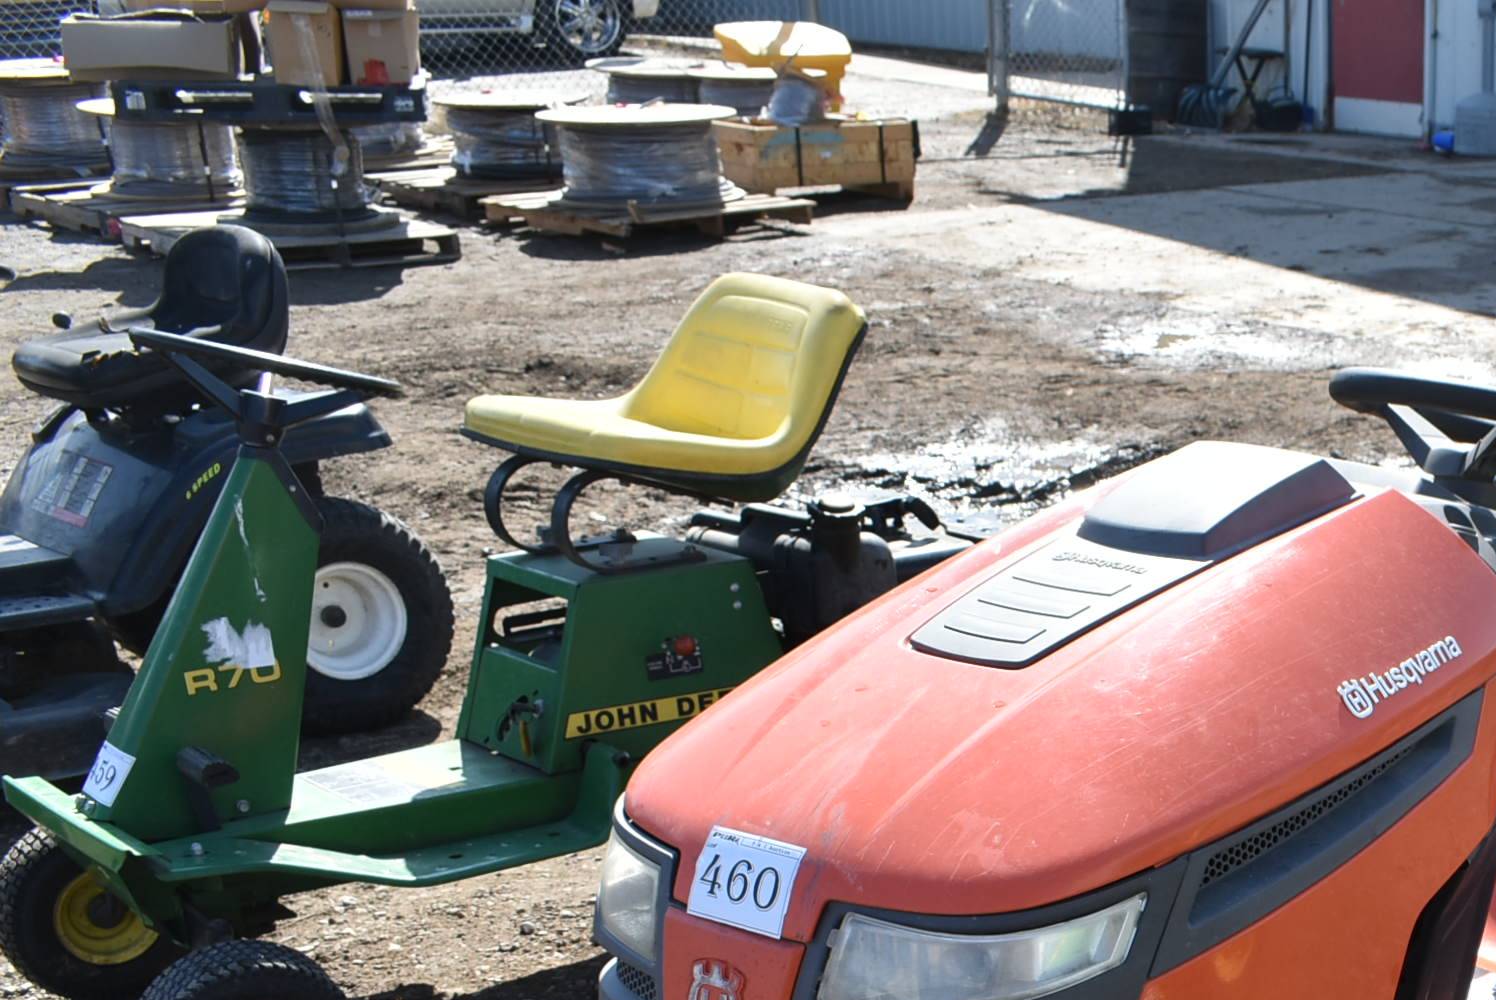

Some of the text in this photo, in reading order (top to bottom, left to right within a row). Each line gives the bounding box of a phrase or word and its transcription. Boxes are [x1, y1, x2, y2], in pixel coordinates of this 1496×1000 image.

[1359, 635, 1463, 704] Husqvarna
[576, 702, 659, 734] JOHN
[700, 854, 780, 910] 460
